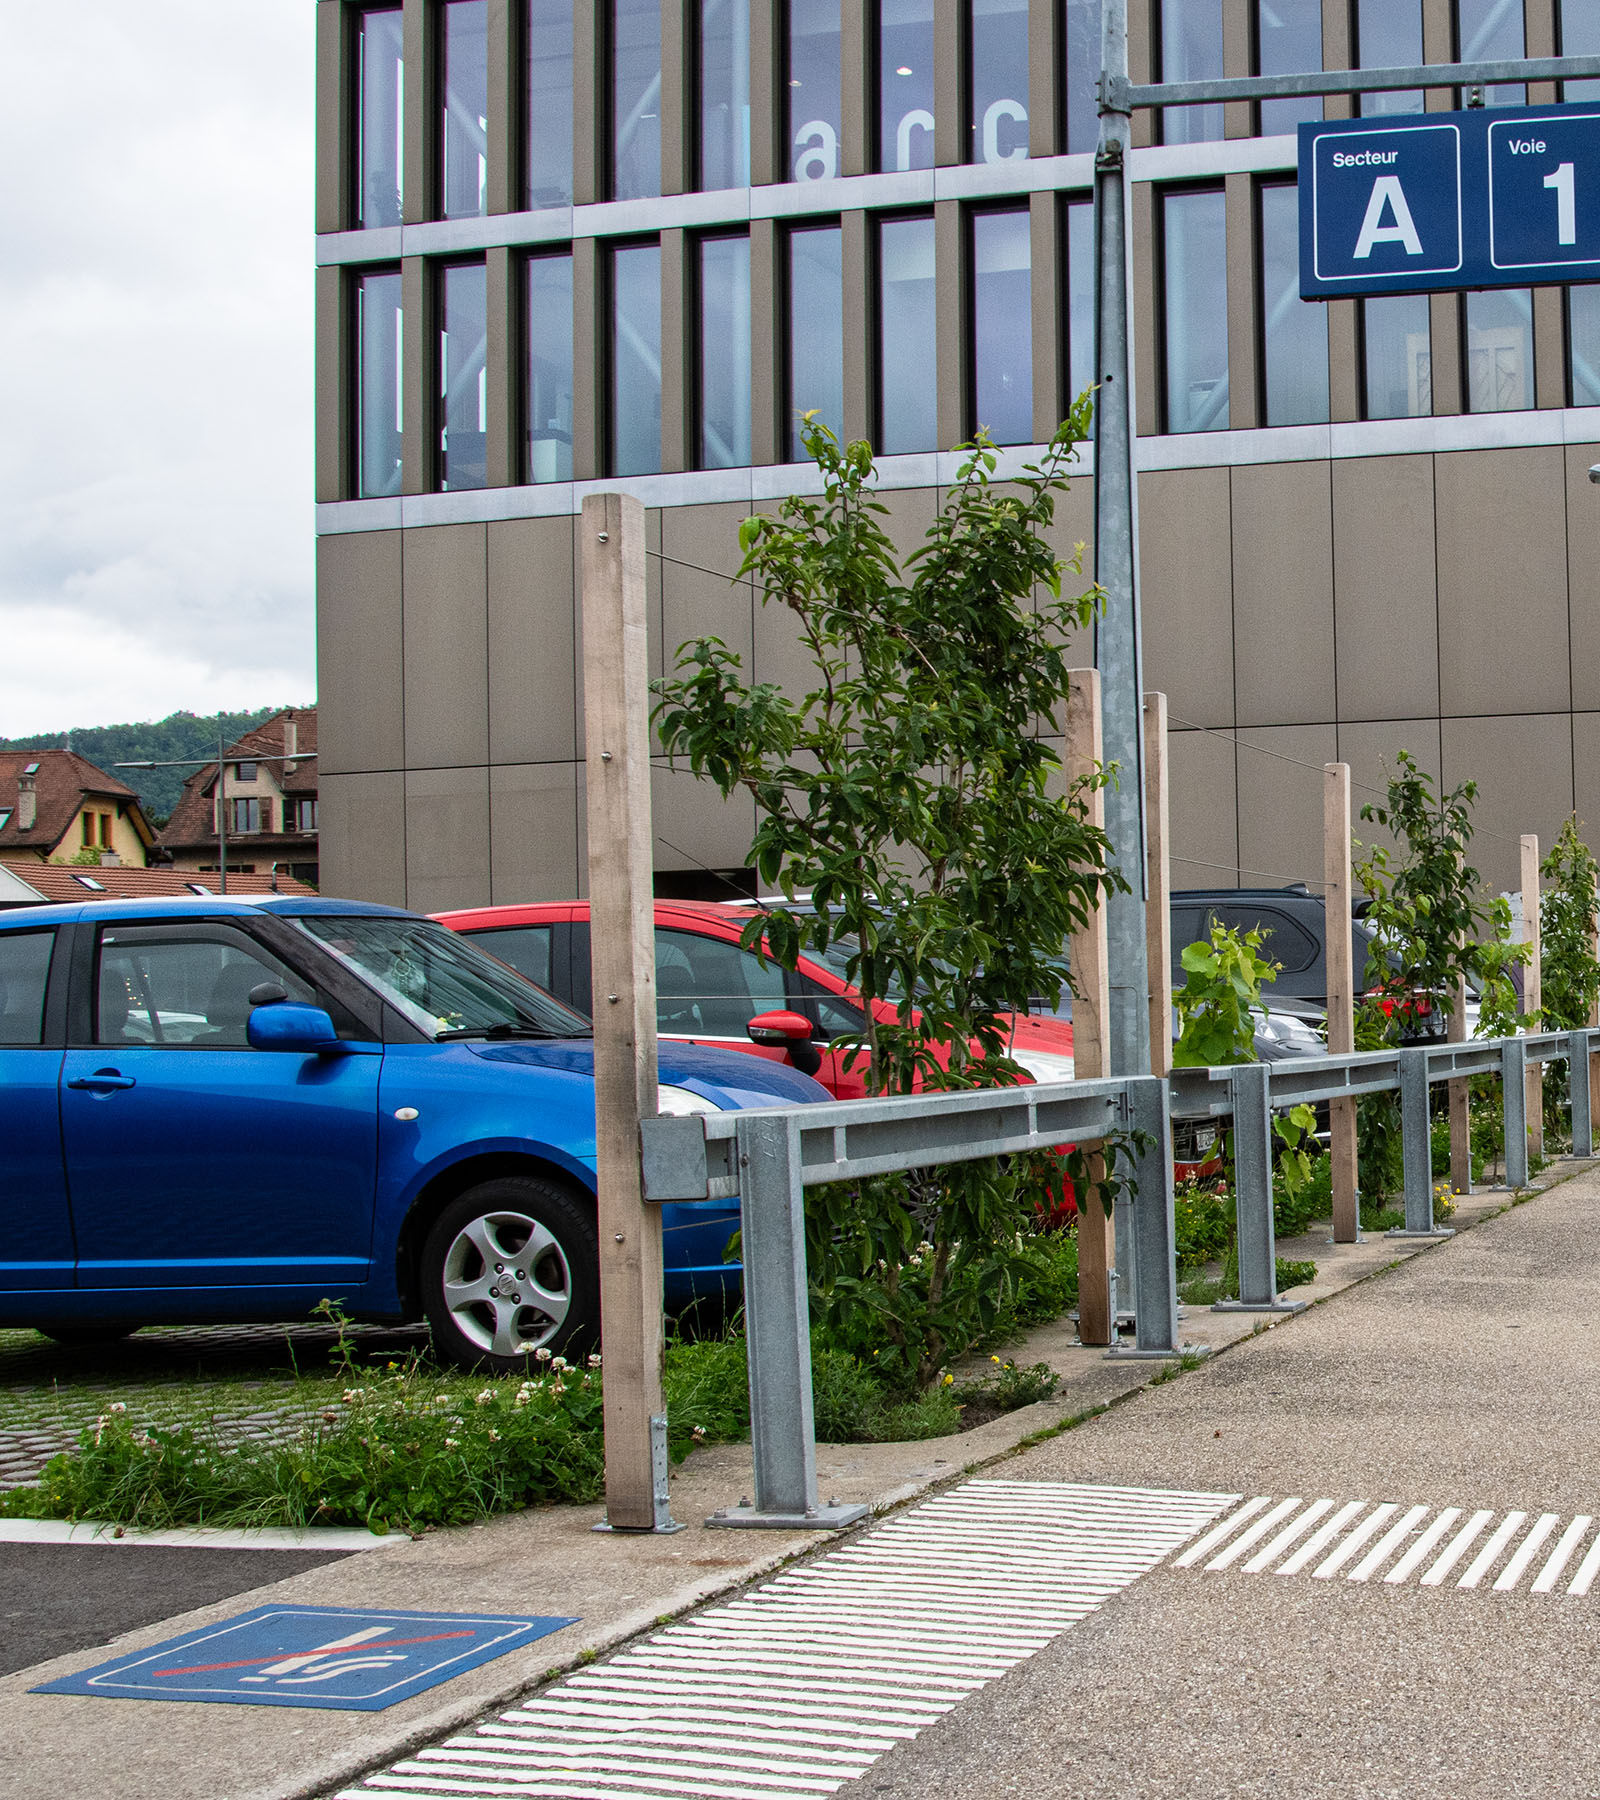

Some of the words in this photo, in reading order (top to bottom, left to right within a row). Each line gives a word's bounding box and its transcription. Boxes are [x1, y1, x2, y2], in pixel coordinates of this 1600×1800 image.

[794, 98, 1029, 183] arc
[1332, 149, 1399, 168] Secteur
[1508, 138, 1547, 156] Voie
[1352, 175, 1424, 259] A
[1543, 161, 1576, 246] 1
